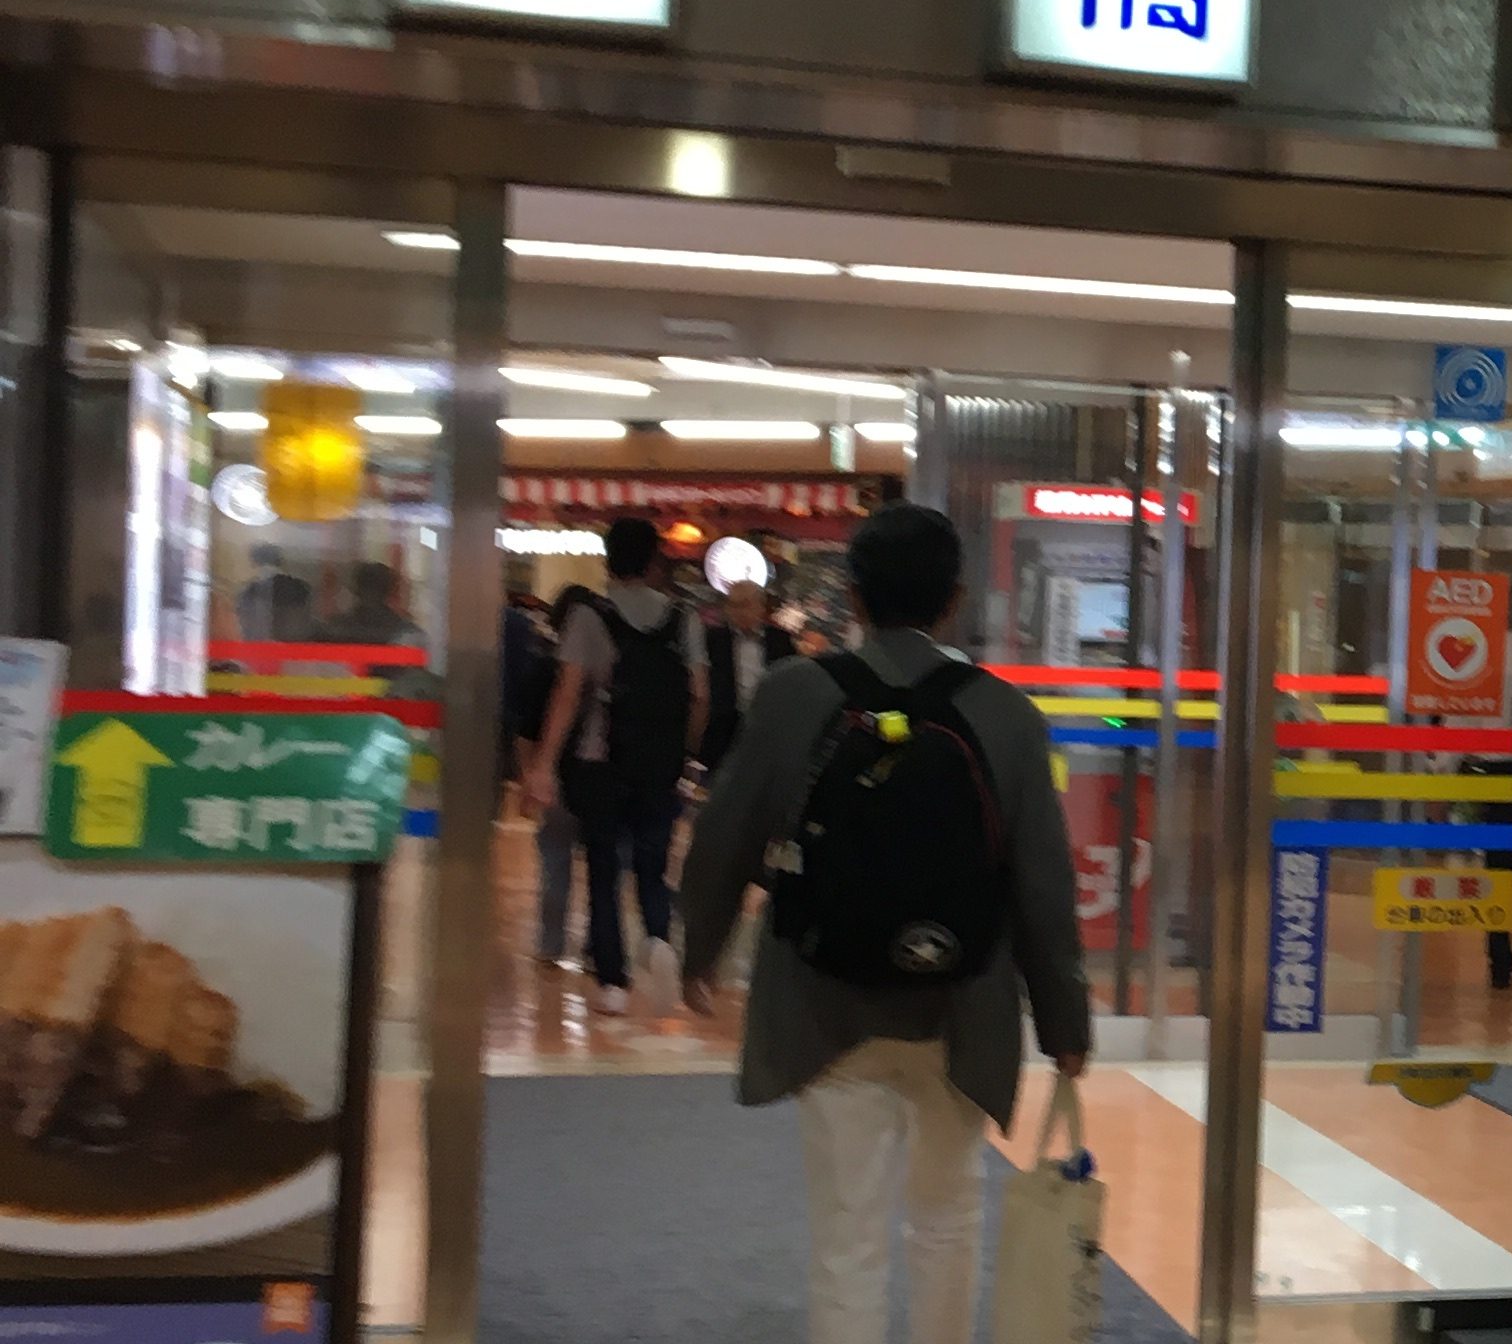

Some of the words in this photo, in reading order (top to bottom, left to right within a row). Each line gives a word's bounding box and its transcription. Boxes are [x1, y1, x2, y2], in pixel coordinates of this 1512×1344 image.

[1428, 576, 1495, 605] AED
[181, 795, 382, 851] 専門店
